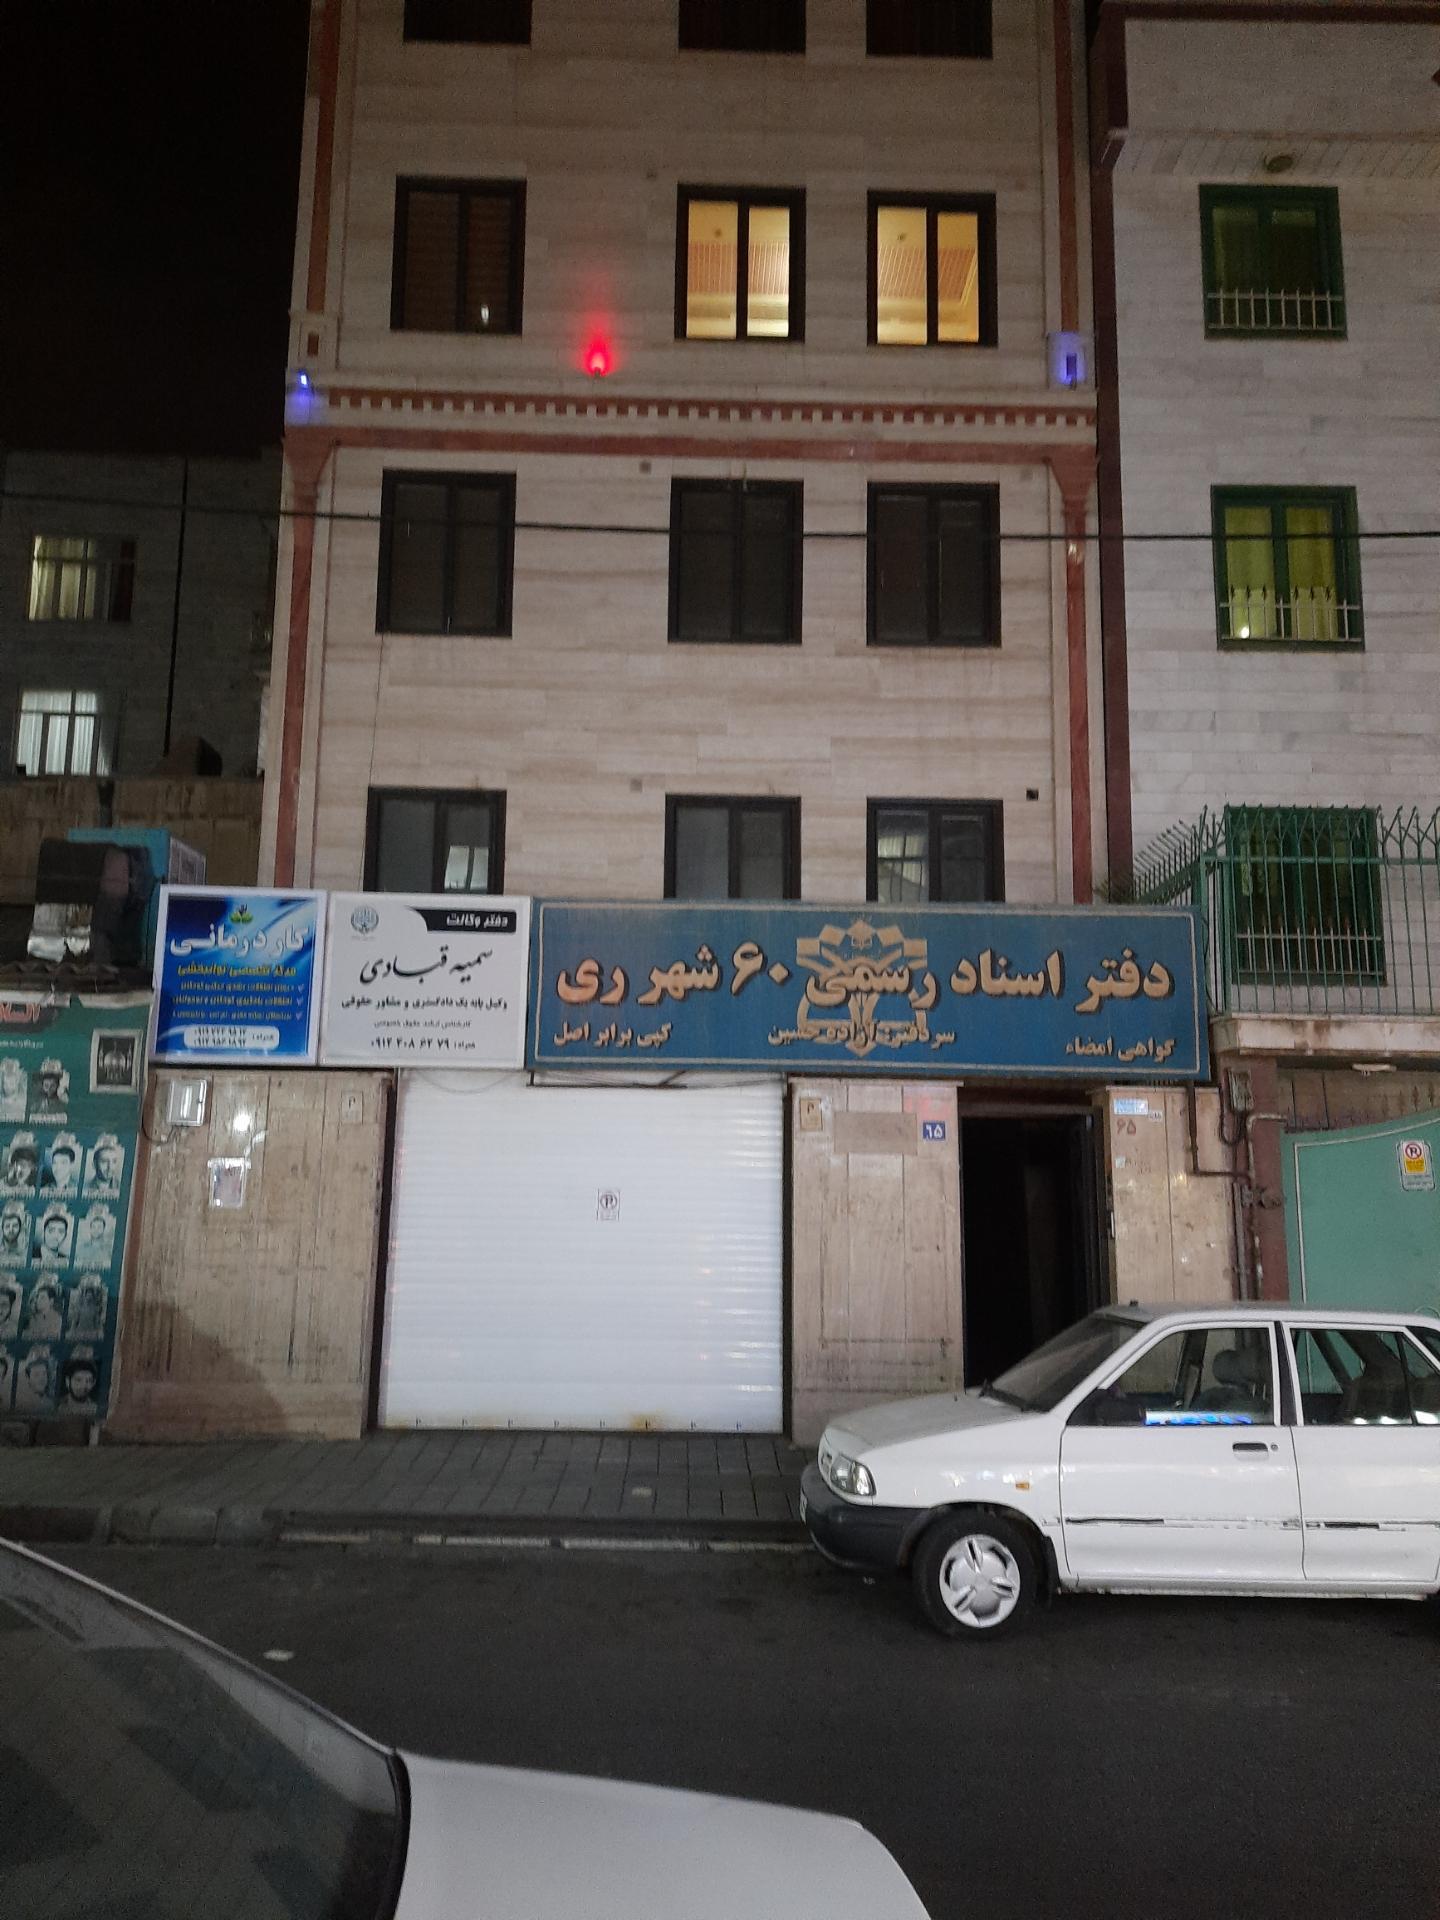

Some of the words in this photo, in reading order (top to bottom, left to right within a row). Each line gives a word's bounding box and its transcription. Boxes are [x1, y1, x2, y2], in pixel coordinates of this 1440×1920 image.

[446, 912, 480, 928] وکالت
[483, 914, 508, 928] دفتر
[360, 944, 449, 985] قبادی
[450, 949, 493, 983] سمیه
[637, 944, 720, 1006] شهر
[731, 941, 789, 996] ۶۰
[951, 947, 1061, 997] اسناد
[557, 958, 627, 1005] ری
[806, 965, 937, 1009] رسمی
[1074, 948, 1172, 1013] دفتر
[341, 996, 371, 1010] حقوقی
[375, 996, 401, 1010] مشاور
[412, 996, 453, 1009] دادگستری
[553, 1020, 590, 1046] اصل
[593, 1021, 632, 1048] برابر
[636, 1022, 673, 1048] کپی
[1117, 1036, 1175, 1062] گواهی
